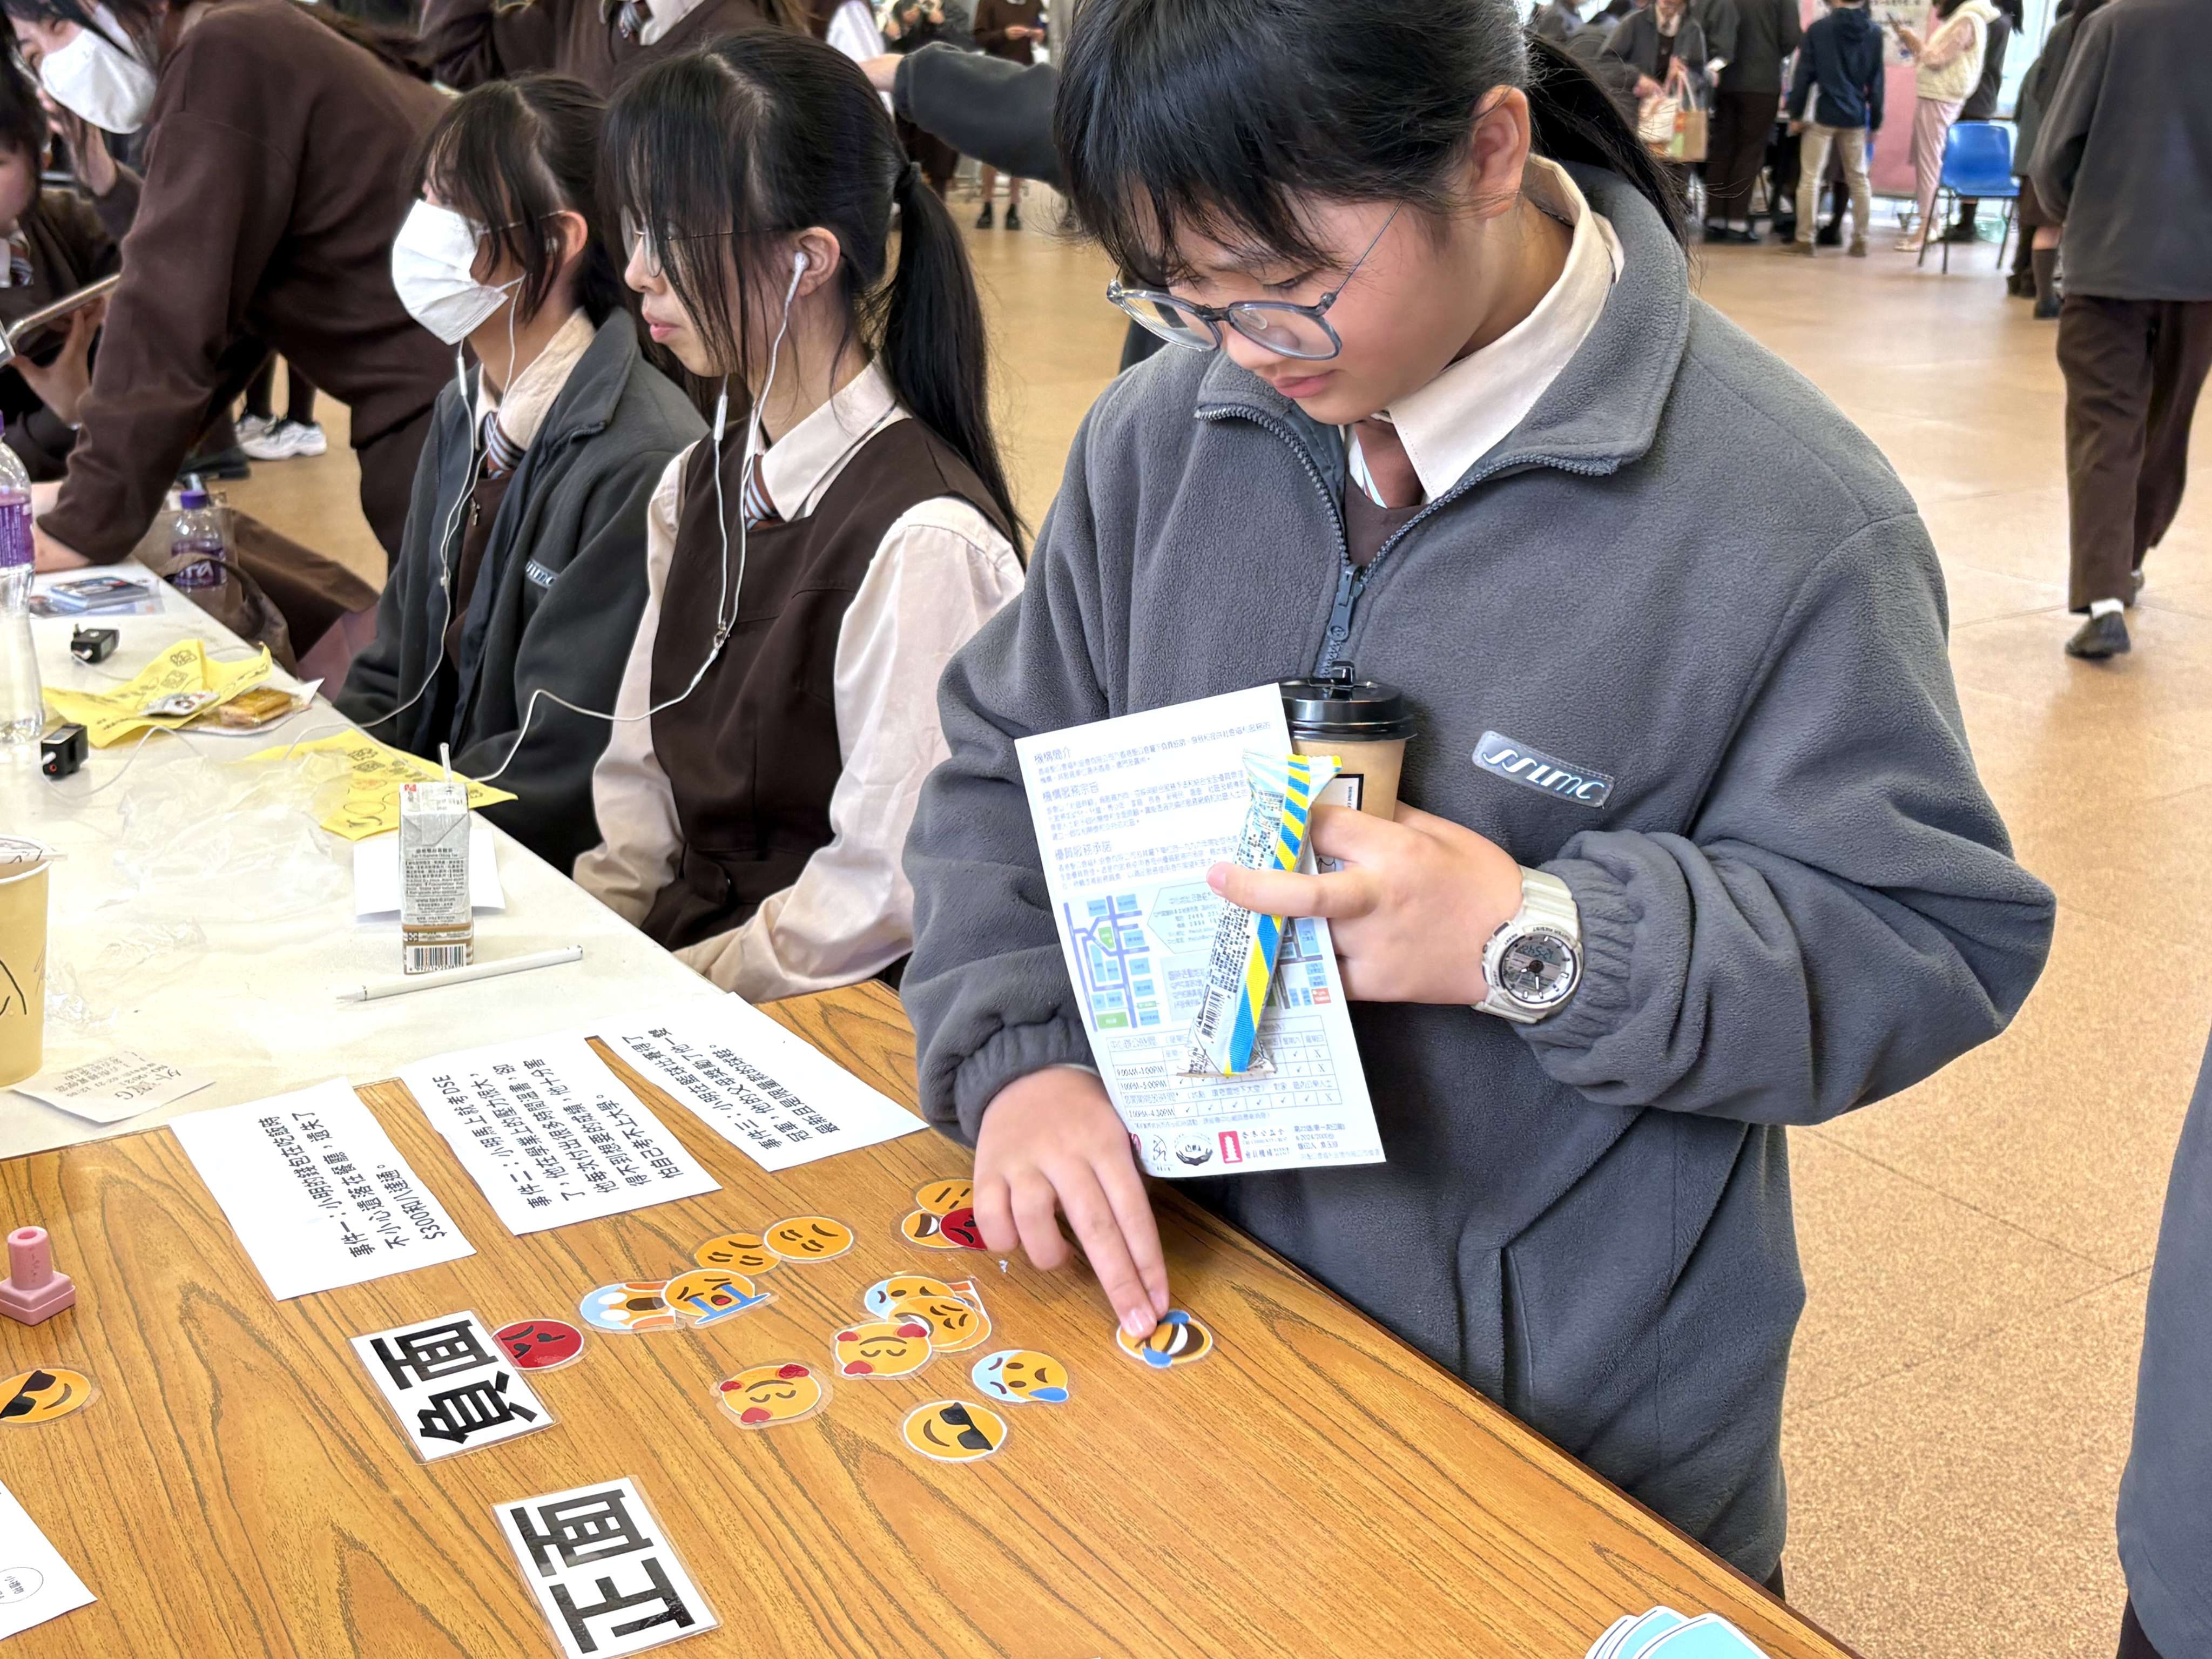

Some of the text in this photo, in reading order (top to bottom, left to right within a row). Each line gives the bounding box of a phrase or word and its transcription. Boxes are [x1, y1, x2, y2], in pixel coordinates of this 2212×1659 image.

[258, 1116, 375, 1257] 事件一：小明的錢包在吃飯時
[596, 1095, 684, 1178] 怕自己考不上大學。
[369, 1319, 537, 1444] 負面
[510, 1489, 695, 1654] 正面
